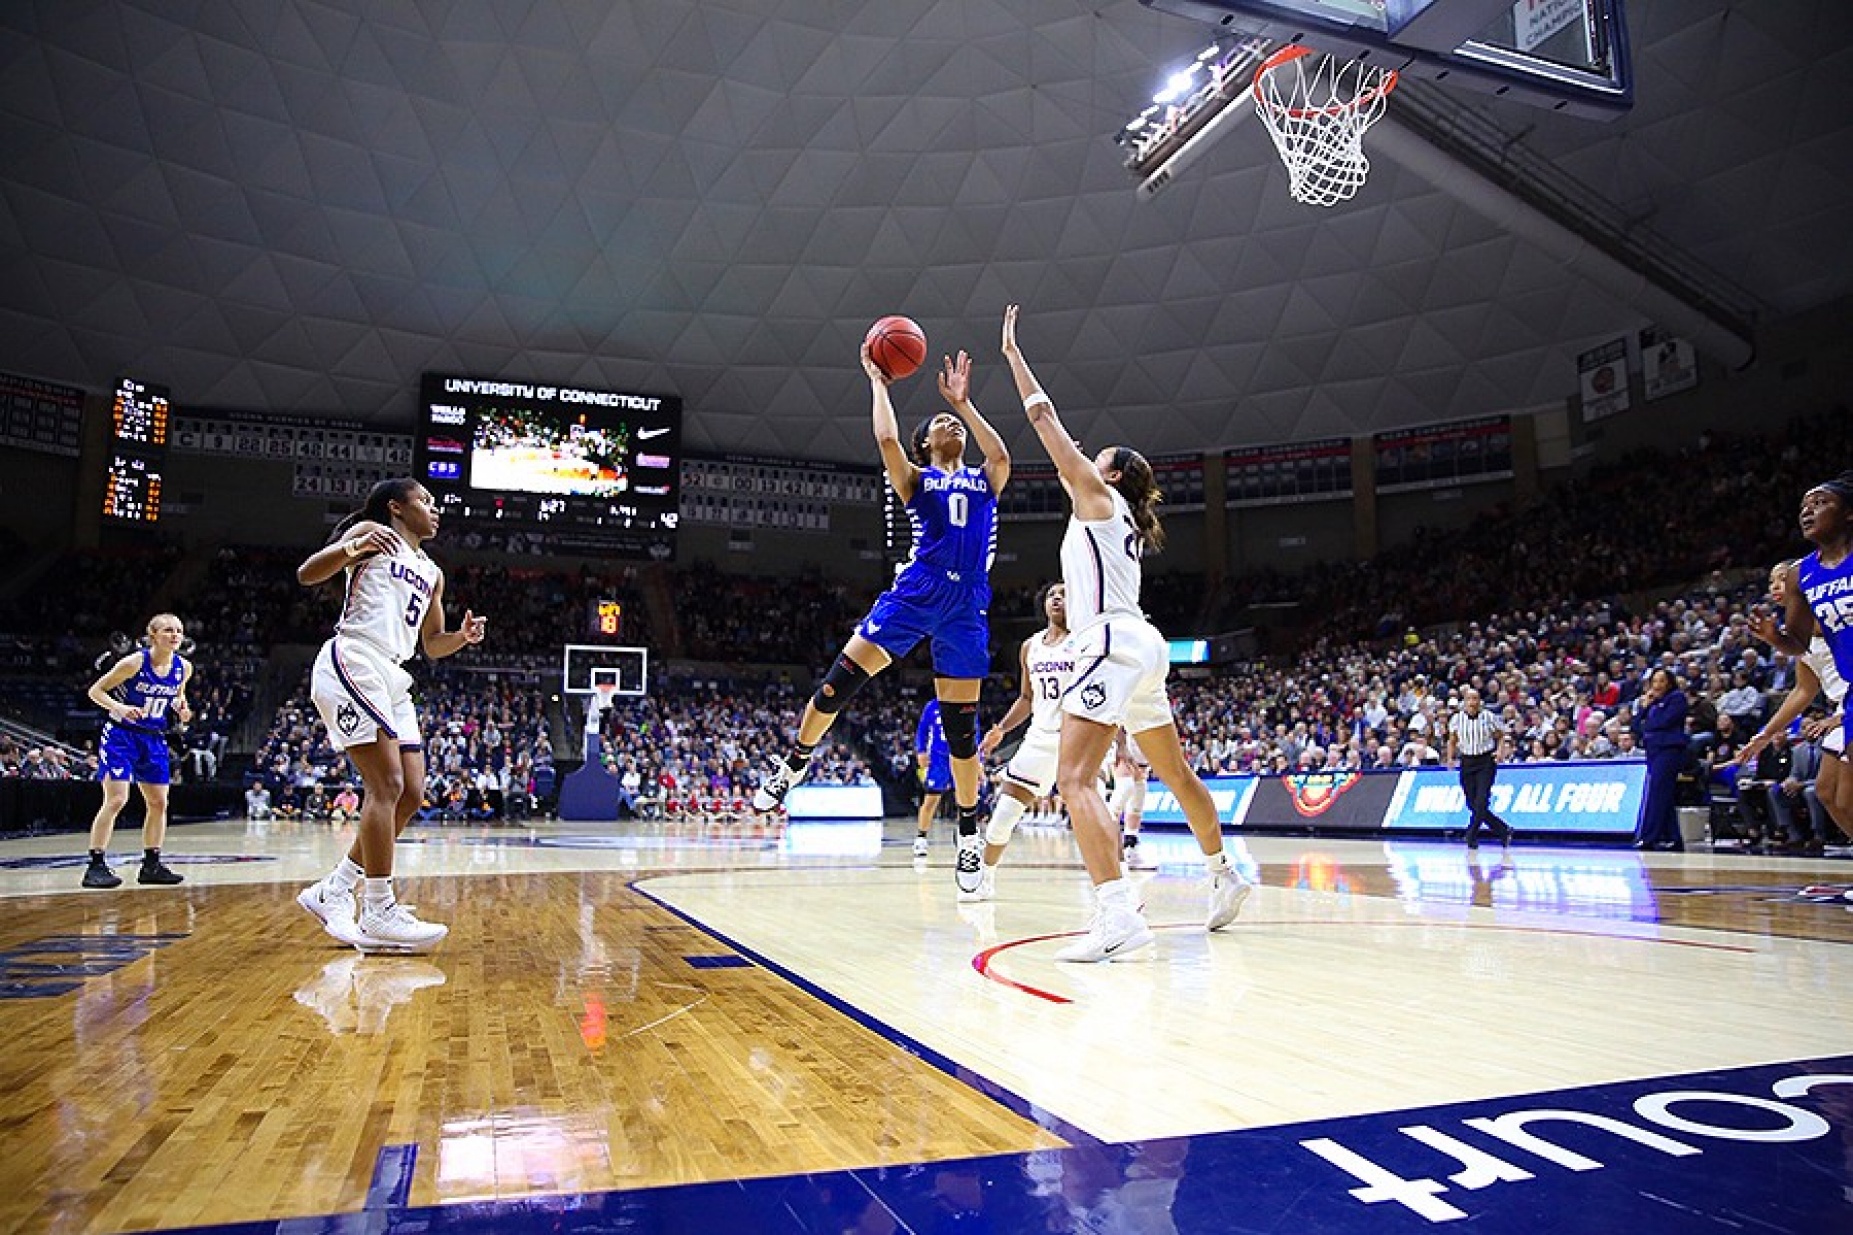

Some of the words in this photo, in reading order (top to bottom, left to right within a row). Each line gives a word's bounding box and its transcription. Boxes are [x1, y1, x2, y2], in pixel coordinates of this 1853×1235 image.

[444, 378, 534, 399] UNIVERSITY
[536, 387, 557, 400] OF
[559, 389, 661, 411] CONNECTICUT
[924, 477, 987, 494] BUFFALO
[947, 492, 969, 527] 0
[405, 592, 423, 628] 5
[1814, 595, 1853, 634] 25
[1039, 677, 1060, 700] 13
[142, 696, 169, 719] 10
[1510, 783, 1553, 813] ALL
[1554, 782, 1628, 814] FOUR
